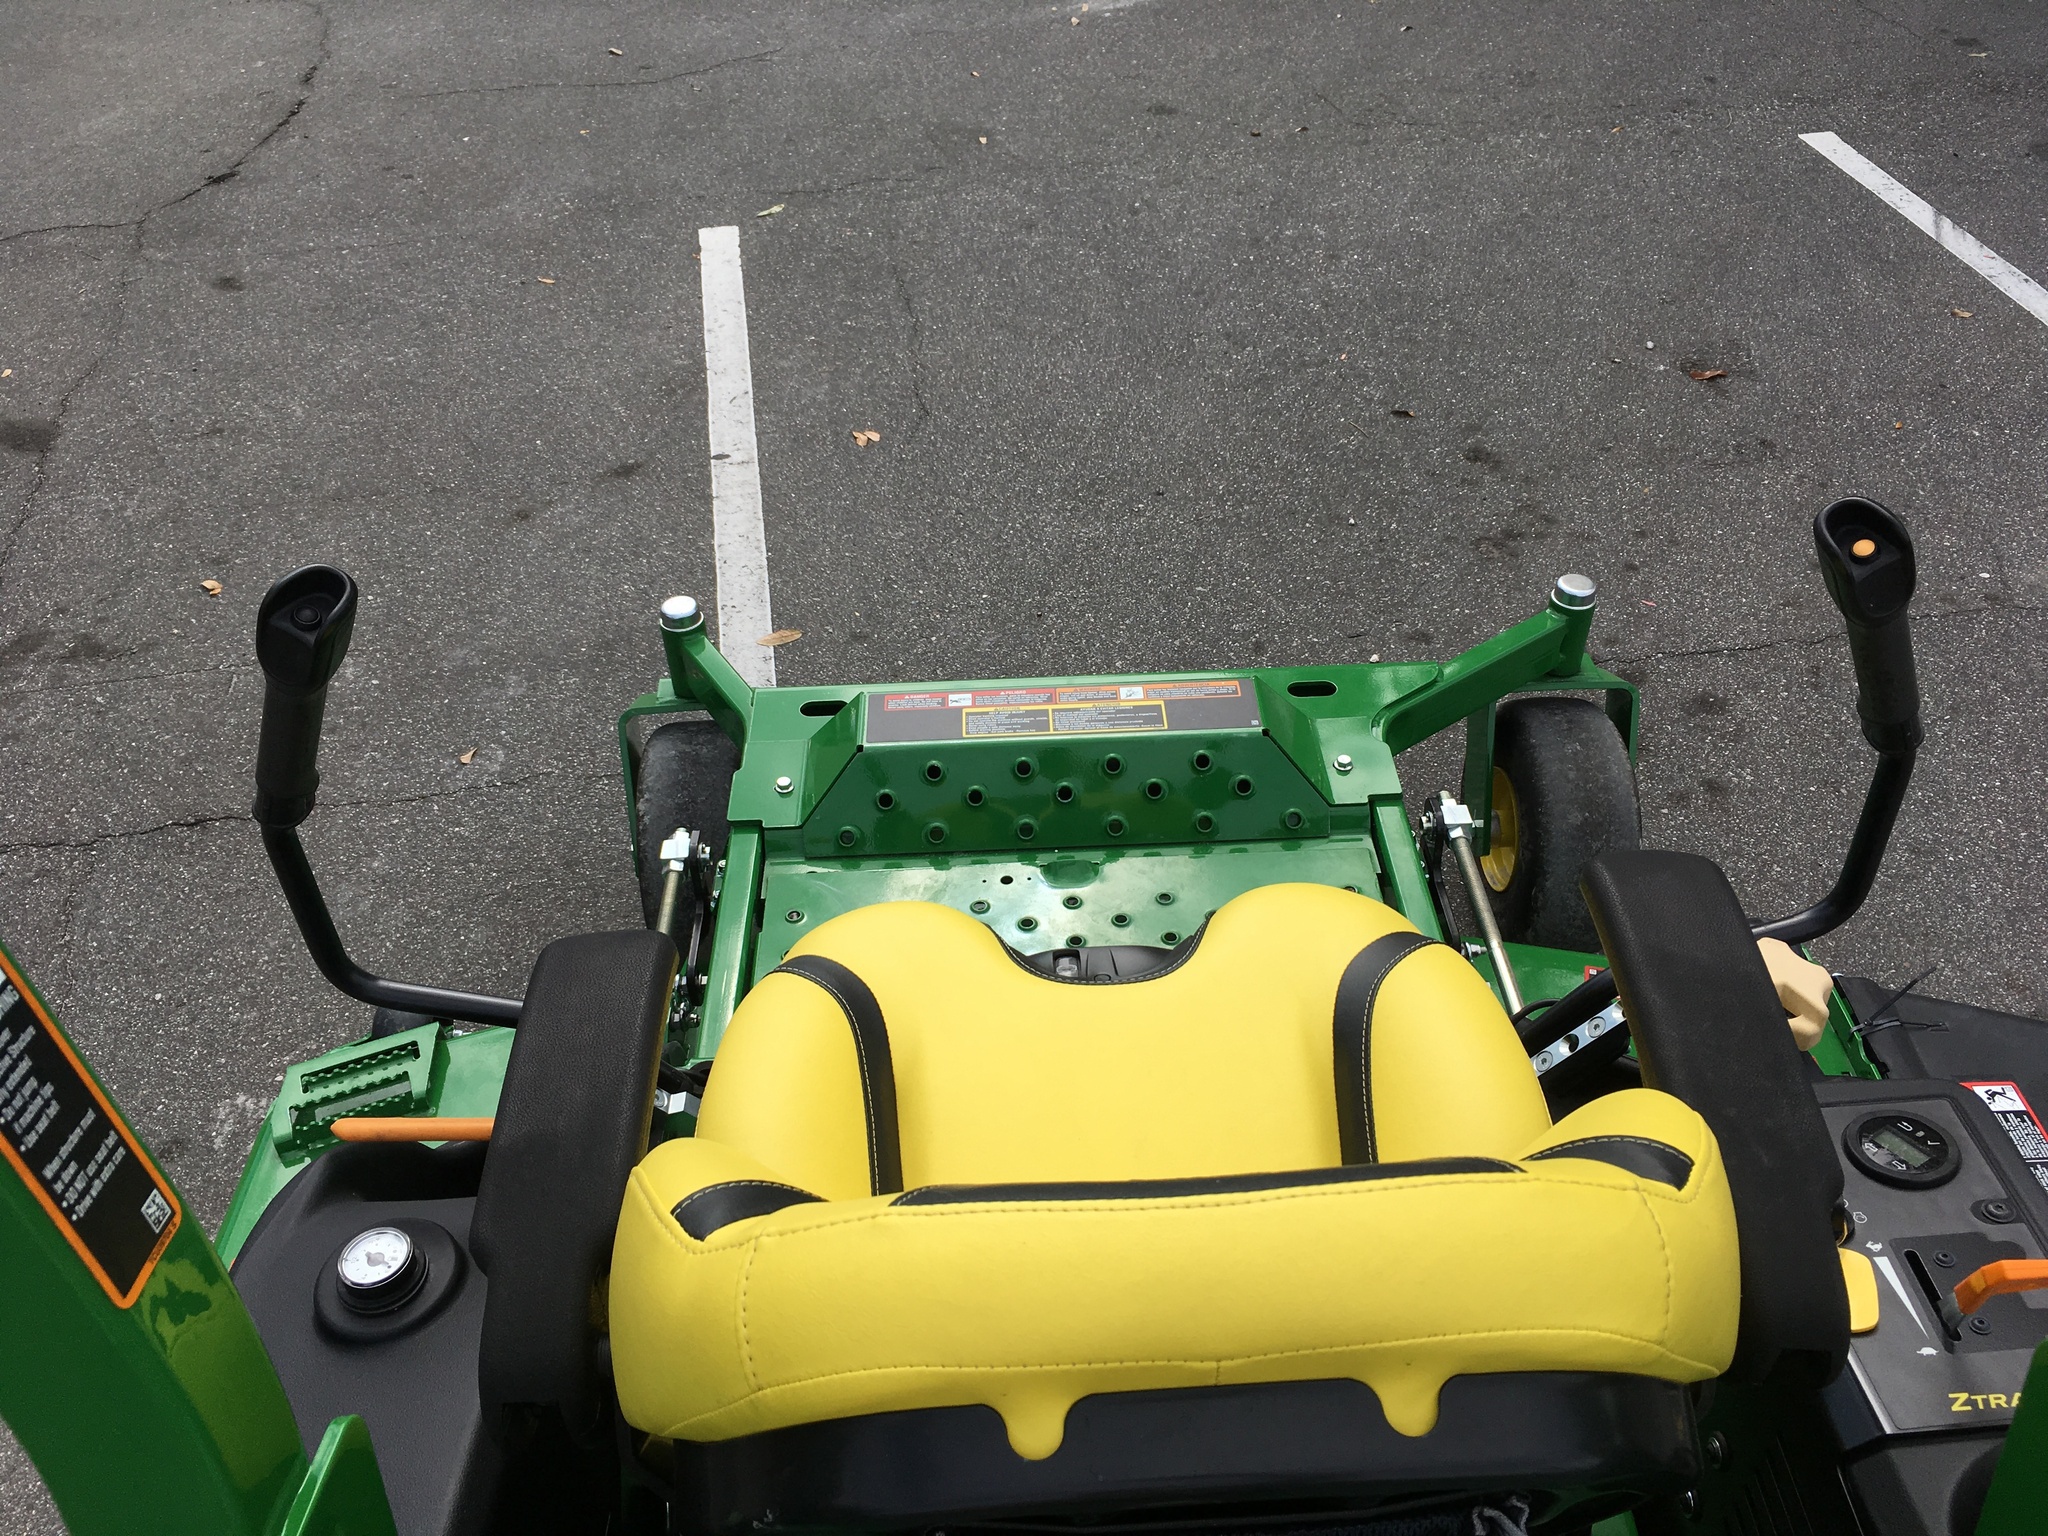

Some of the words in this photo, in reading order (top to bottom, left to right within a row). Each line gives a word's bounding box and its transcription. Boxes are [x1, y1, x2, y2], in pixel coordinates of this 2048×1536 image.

[73, 1170, 89, 1192] NOT
[94, 1143, 109, 1164] seat
[103, 1129, 119, 1149] belt
[89, 1178, 104, 1199] with
[99, 1161, 116, 1183] extra
[112, 1145, 127, 1166] care
